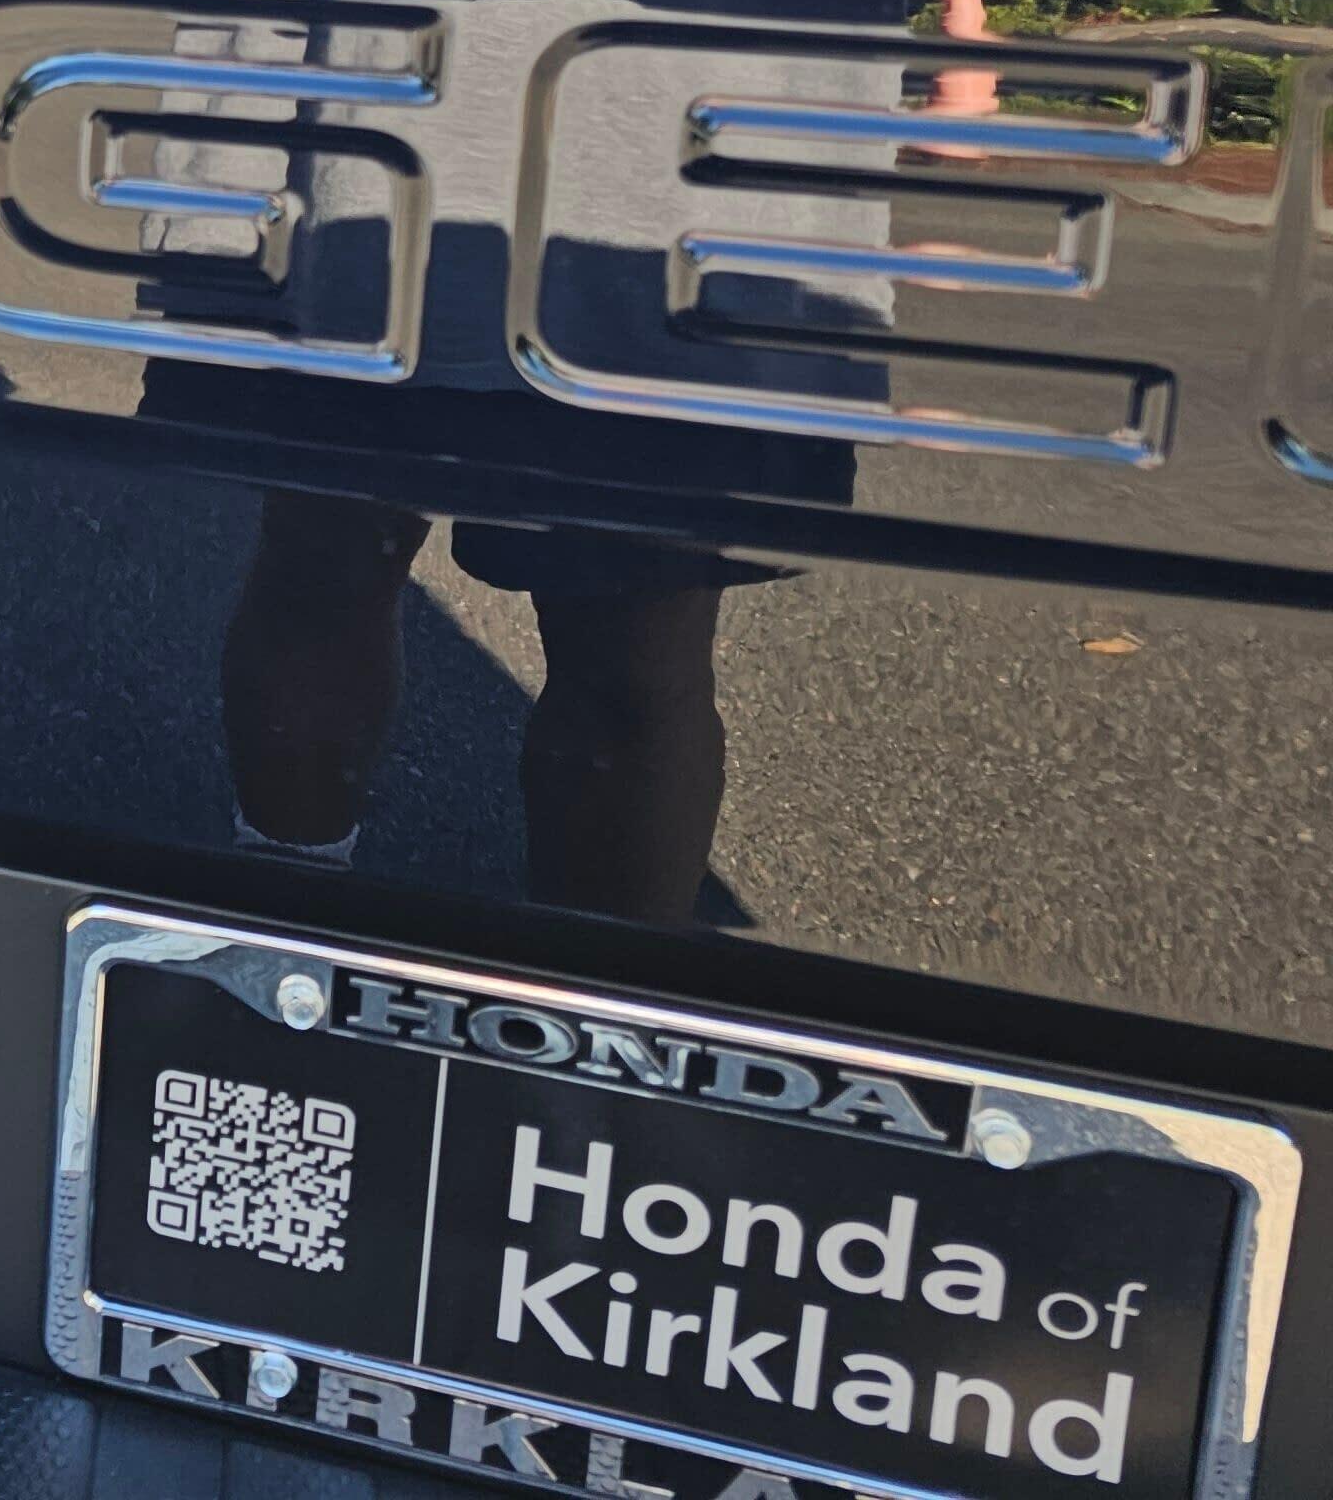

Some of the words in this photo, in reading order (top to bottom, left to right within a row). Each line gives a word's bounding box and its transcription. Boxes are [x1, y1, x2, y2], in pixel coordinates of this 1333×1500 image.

[346, 976, 948, 1141] HONDA
[507, 1125, 1006, 1322] Honda
[1037, 1282, 1148, 1350] of
[496, 1246, 1133, 1484] Kirkland
